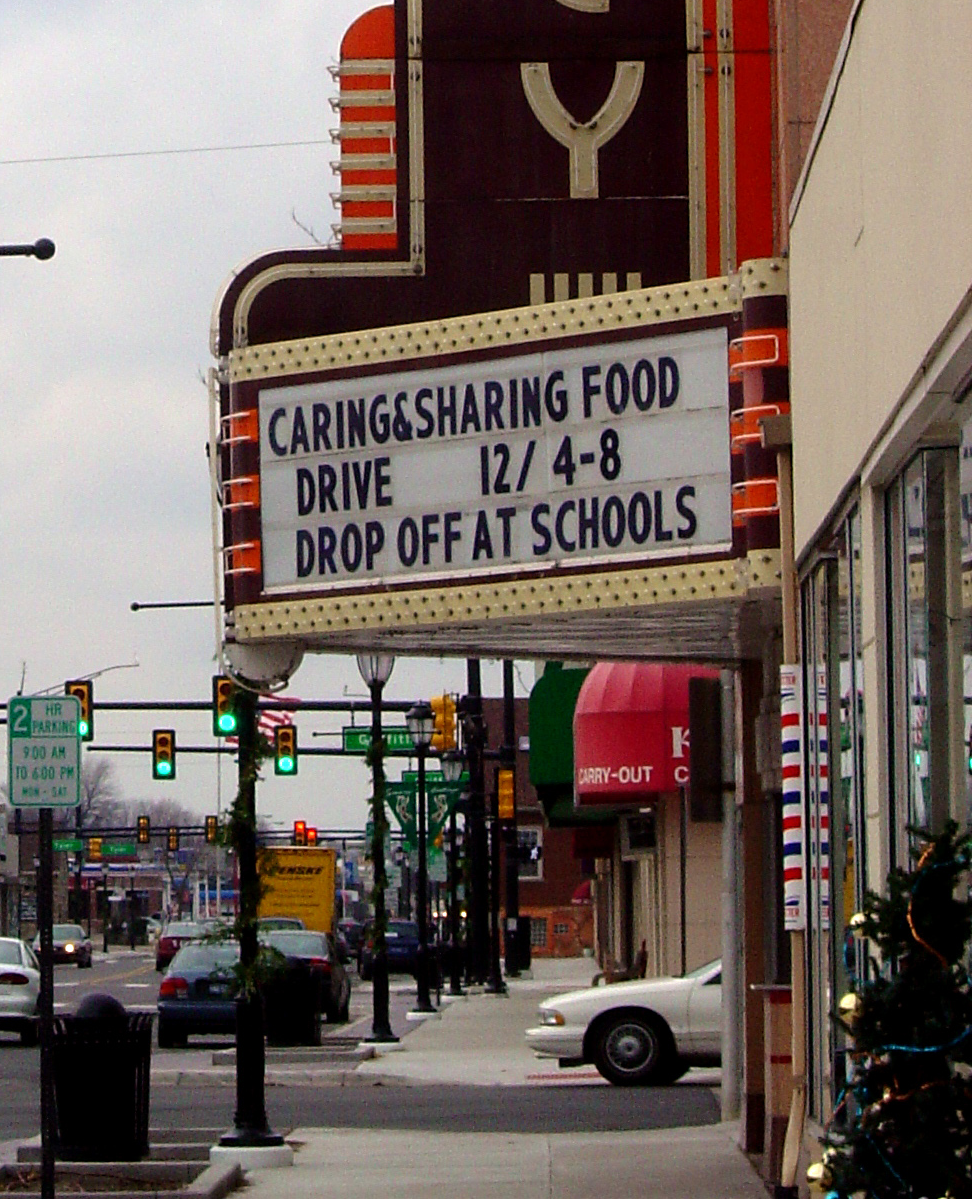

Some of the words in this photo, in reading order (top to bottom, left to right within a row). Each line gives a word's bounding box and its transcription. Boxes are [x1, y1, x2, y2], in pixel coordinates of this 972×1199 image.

[582, 357, 680, 418] FOOD
[296, 456, 393, 517] DRIVE
[296, 520, 385, 579] DROP
[397, 512, 462, 568] OFF
[472, 507, 517, 561] AT
[531, 485, 697, 557] SCHOOLS
[13, 705, 28, 732] 2
[46, 702, 62, 716] HR
[33, 720, 75, 734] PARKING
[51, 746, 66, 759] AM
[60, 766, 74, 779] PM
[579, 766, 653, 784] CARRY-OUT
